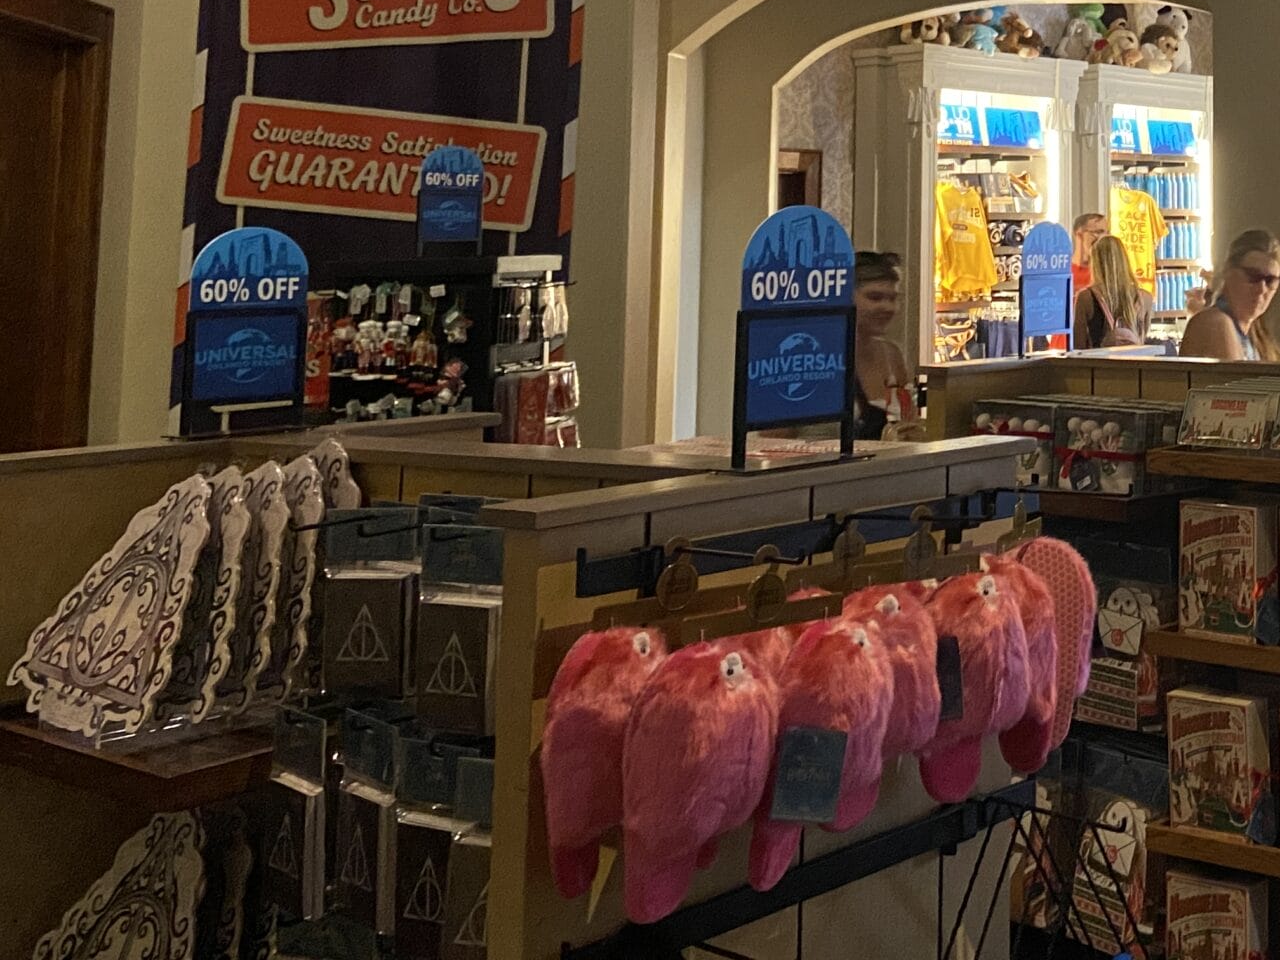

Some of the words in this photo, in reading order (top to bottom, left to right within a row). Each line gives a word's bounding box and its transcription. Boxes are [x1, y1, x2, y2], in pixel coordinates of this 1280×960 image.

[253, 118, 372, 151] Sweetness
[425, 172, 453, 186] 60%
[456, 173, 479, 187] OFF
[1026, 254, 1048, 269] 60%
[1050, 254, 1069, 269] OFF
[200, 278, 250, 303] 60%
[257, 277, 300, 301] OFF
[751, 270, 800, 300] 60%
[807, 269, 847, 298] OFF
[194, 344, 297, 366] UNIVERSAL
[748, 352, 846, 379] UNIVERSAL
[759, 374, 800, 387] ORLANDO
[803, 371, 837, 382] RESORT
